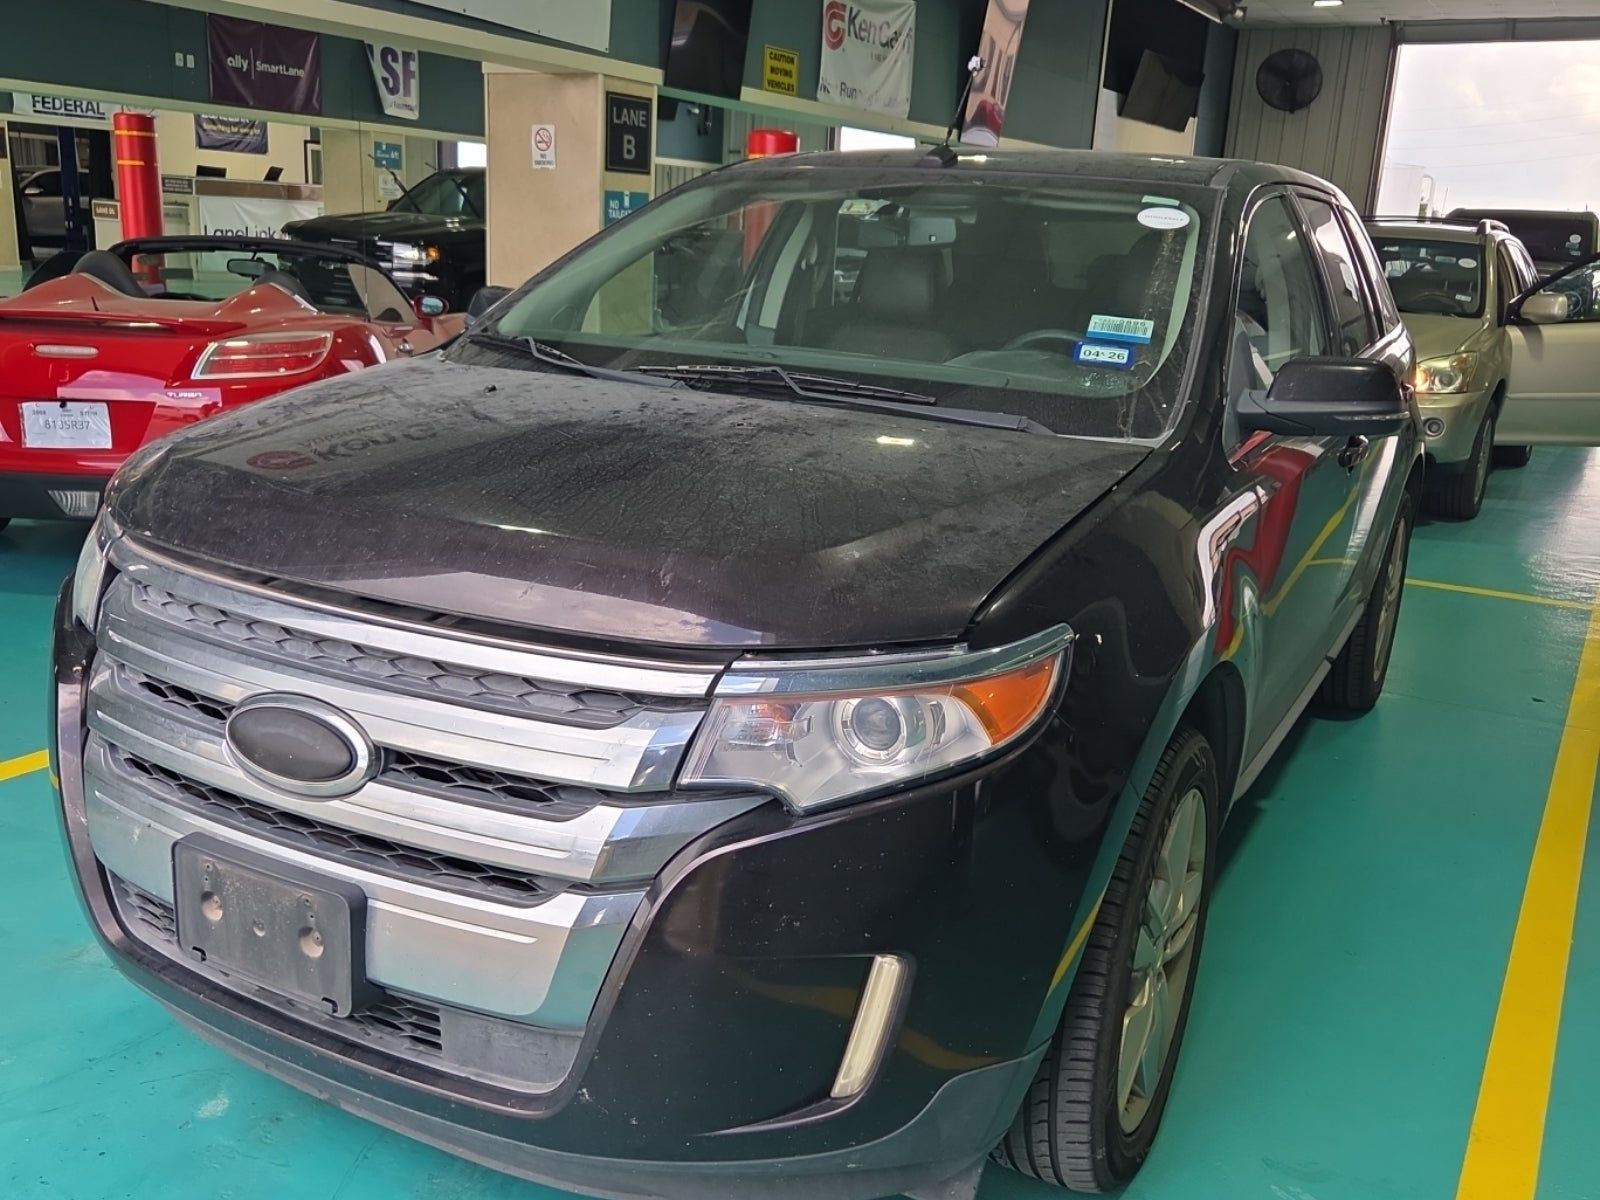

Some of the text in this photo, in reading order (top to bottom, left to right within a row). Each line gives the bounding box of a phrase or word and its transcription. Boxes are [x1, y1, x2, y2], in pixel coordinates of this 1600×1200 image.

[848, 6, 877, 45] Ken
[226, 53, 249, 71] ally
[769, 51, 795, 65] CAUTION
[255, 60, 305, 79] SmartLane
[770, 66, 793, 79] MOVING
[766, 79, 795, 92] VEHICLES
[31, 94, 106, 116] FEDERAL
[613, 106, 647, 128] LANE
[623, 134, 636, 160] B
[608, 208, 632, 219] TAILGAT
[609, 199, 619, 210] NO
